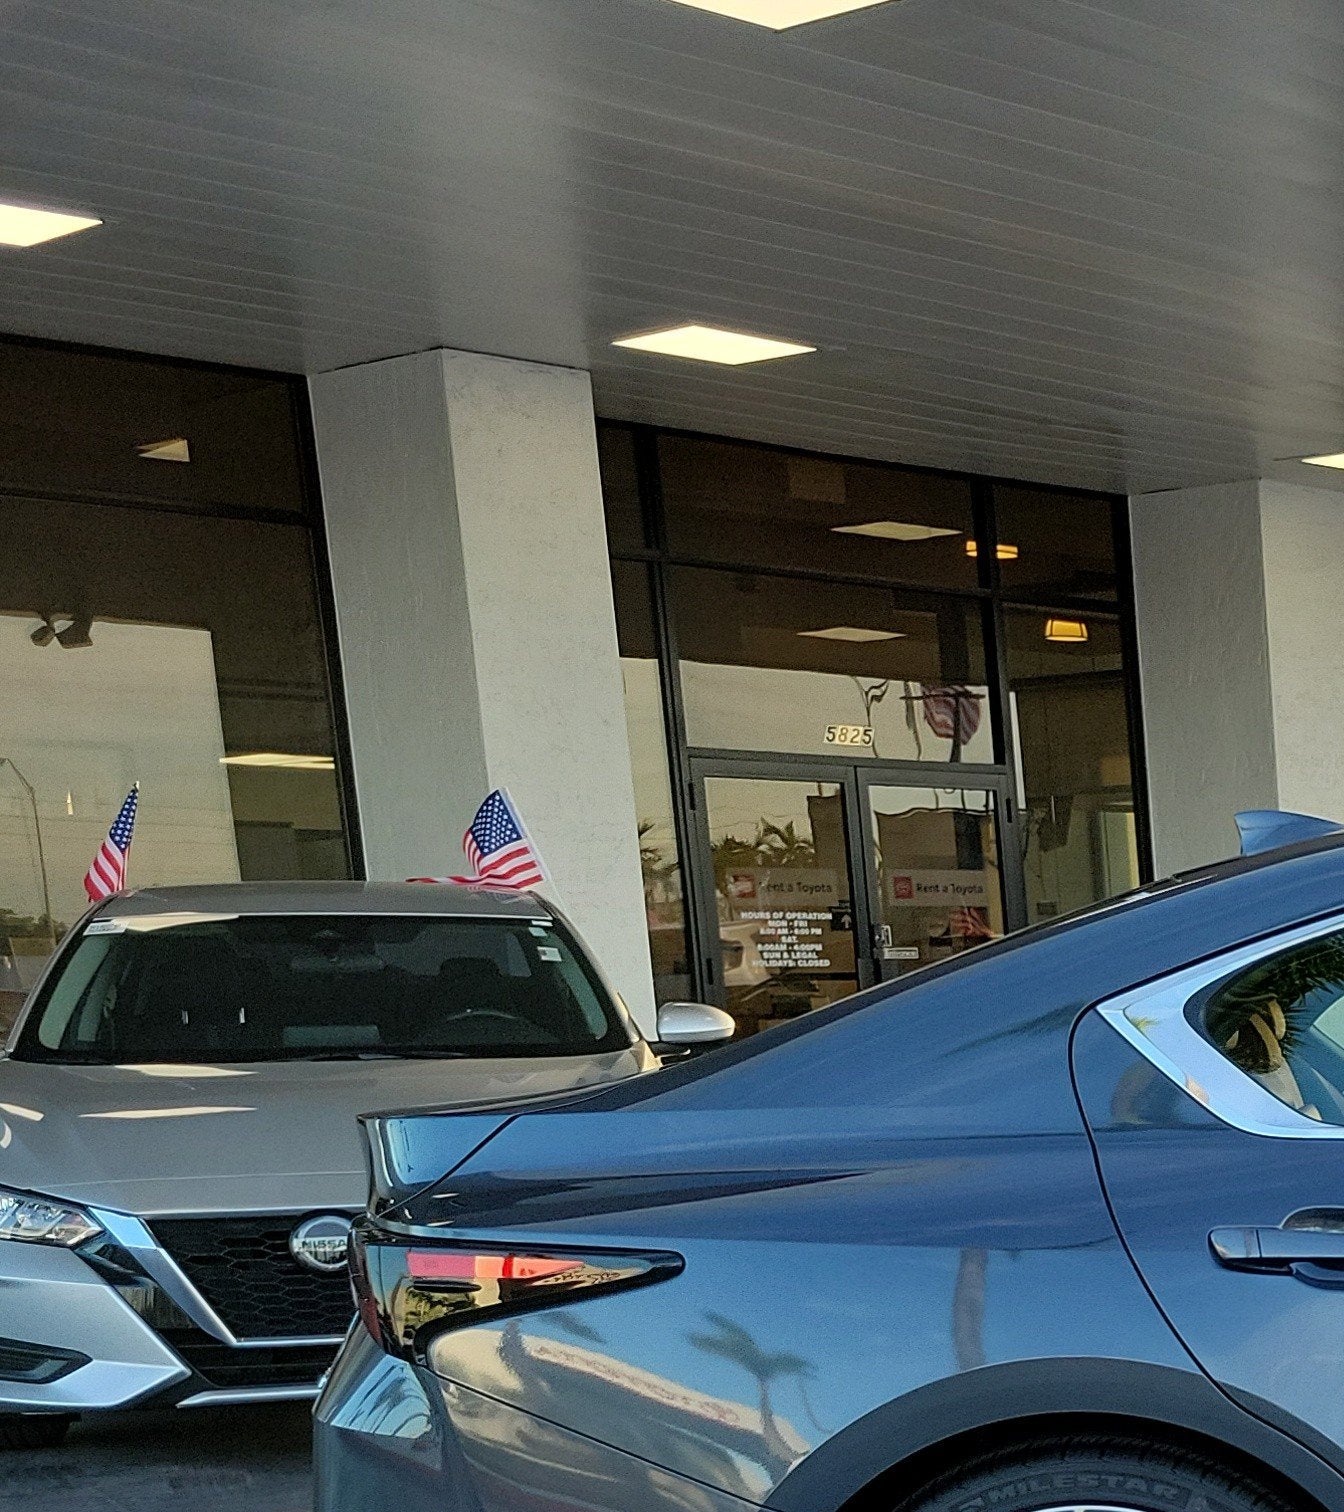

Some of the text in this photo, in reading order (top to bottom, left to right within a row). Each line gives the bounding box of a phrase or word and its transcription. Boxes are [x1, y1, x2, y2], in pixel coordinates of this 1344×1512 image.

[825, 725, 873, 745] 5825
[796, 881, 833, 895] Toyota
[950, 883, 984, 896] Toyota
[741, 911, 833, 921] HOURS OF OPERATION
[791, 951, 818, 959] LEGAL
[797, 959, 831, 967] CLOSED
[301, 1239, 347, 1250] NISSA
[987, 1473, 1180, 1502] MILESTAR
